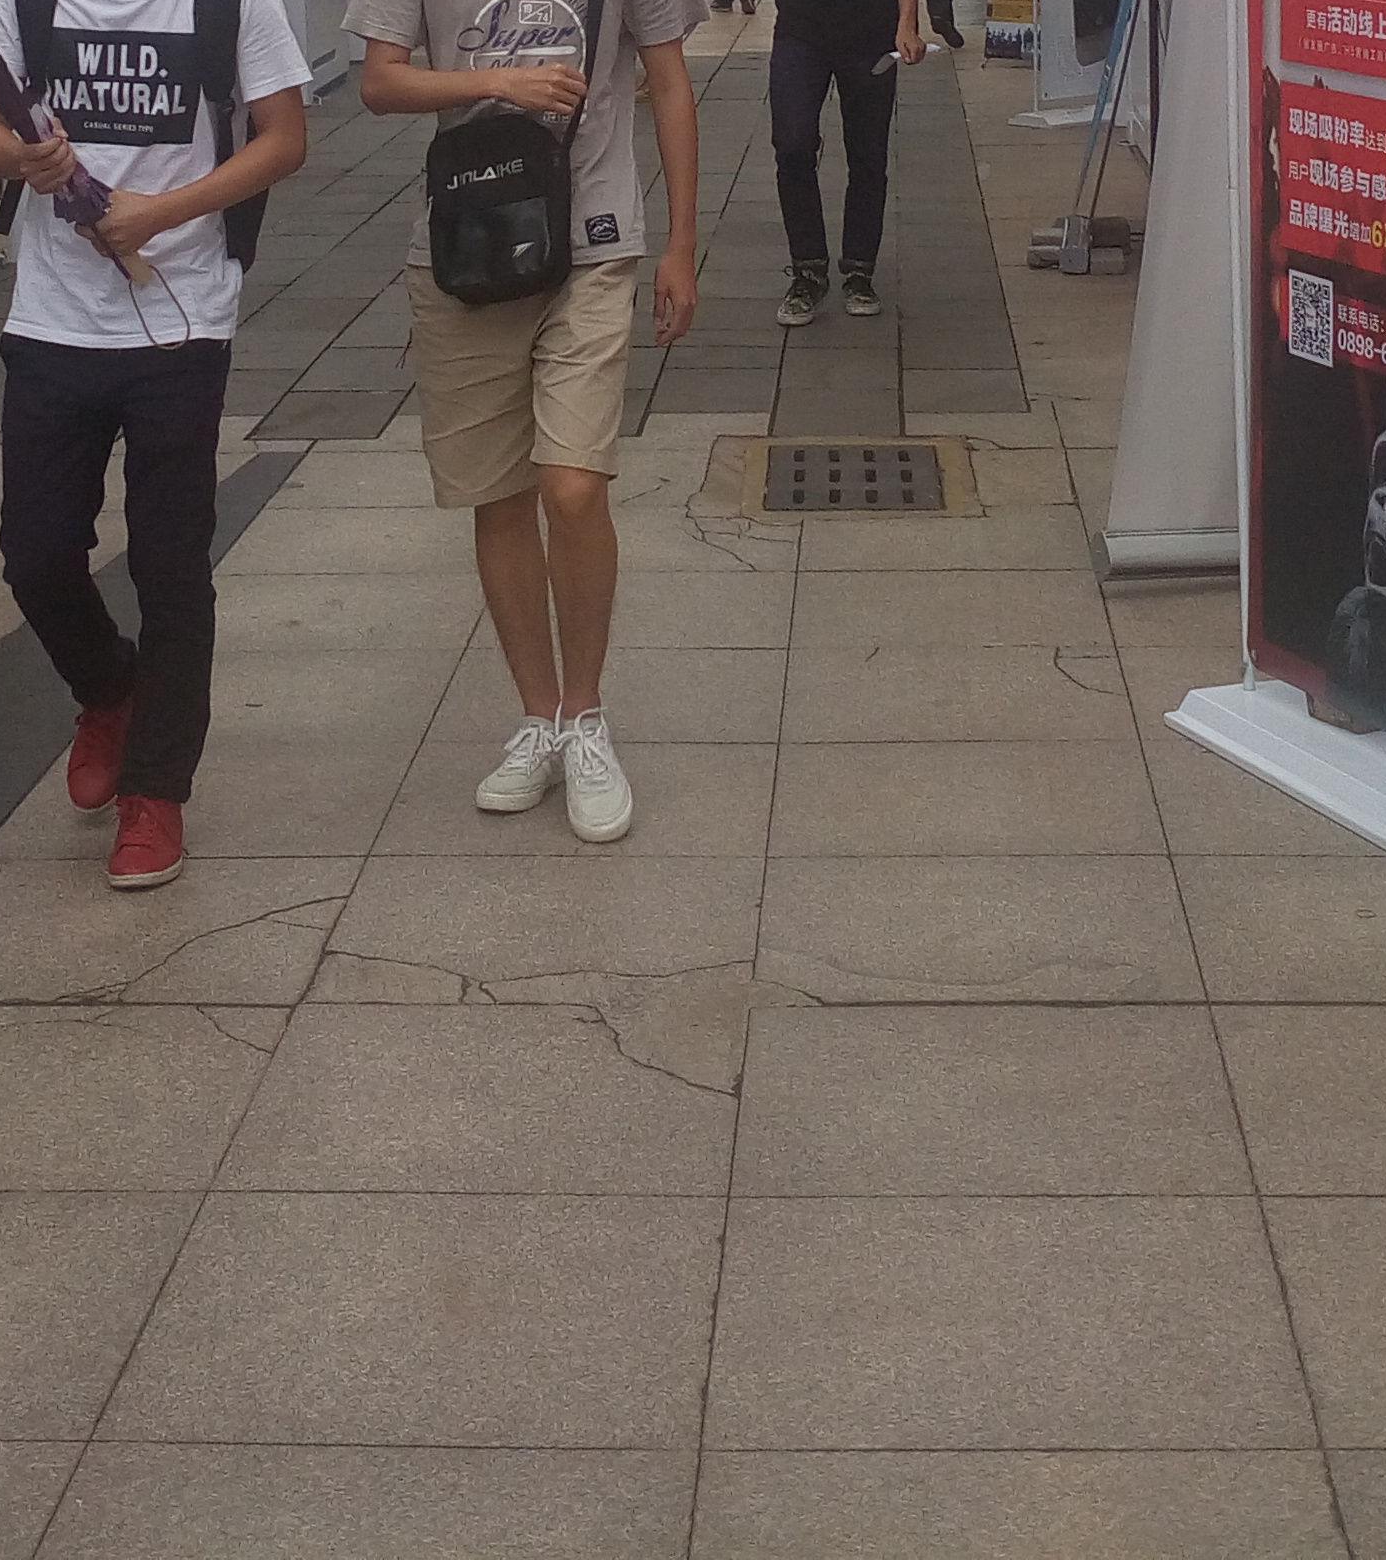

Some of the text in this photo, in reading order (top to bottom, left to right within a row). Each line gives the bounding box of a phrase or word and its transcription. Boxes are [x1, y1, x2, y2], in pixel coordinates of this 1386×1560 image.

[457, 0, 576, 57] Super
[77, 42, 169, 79] WILD.
[53, 78, 187, 117] NATURAL
